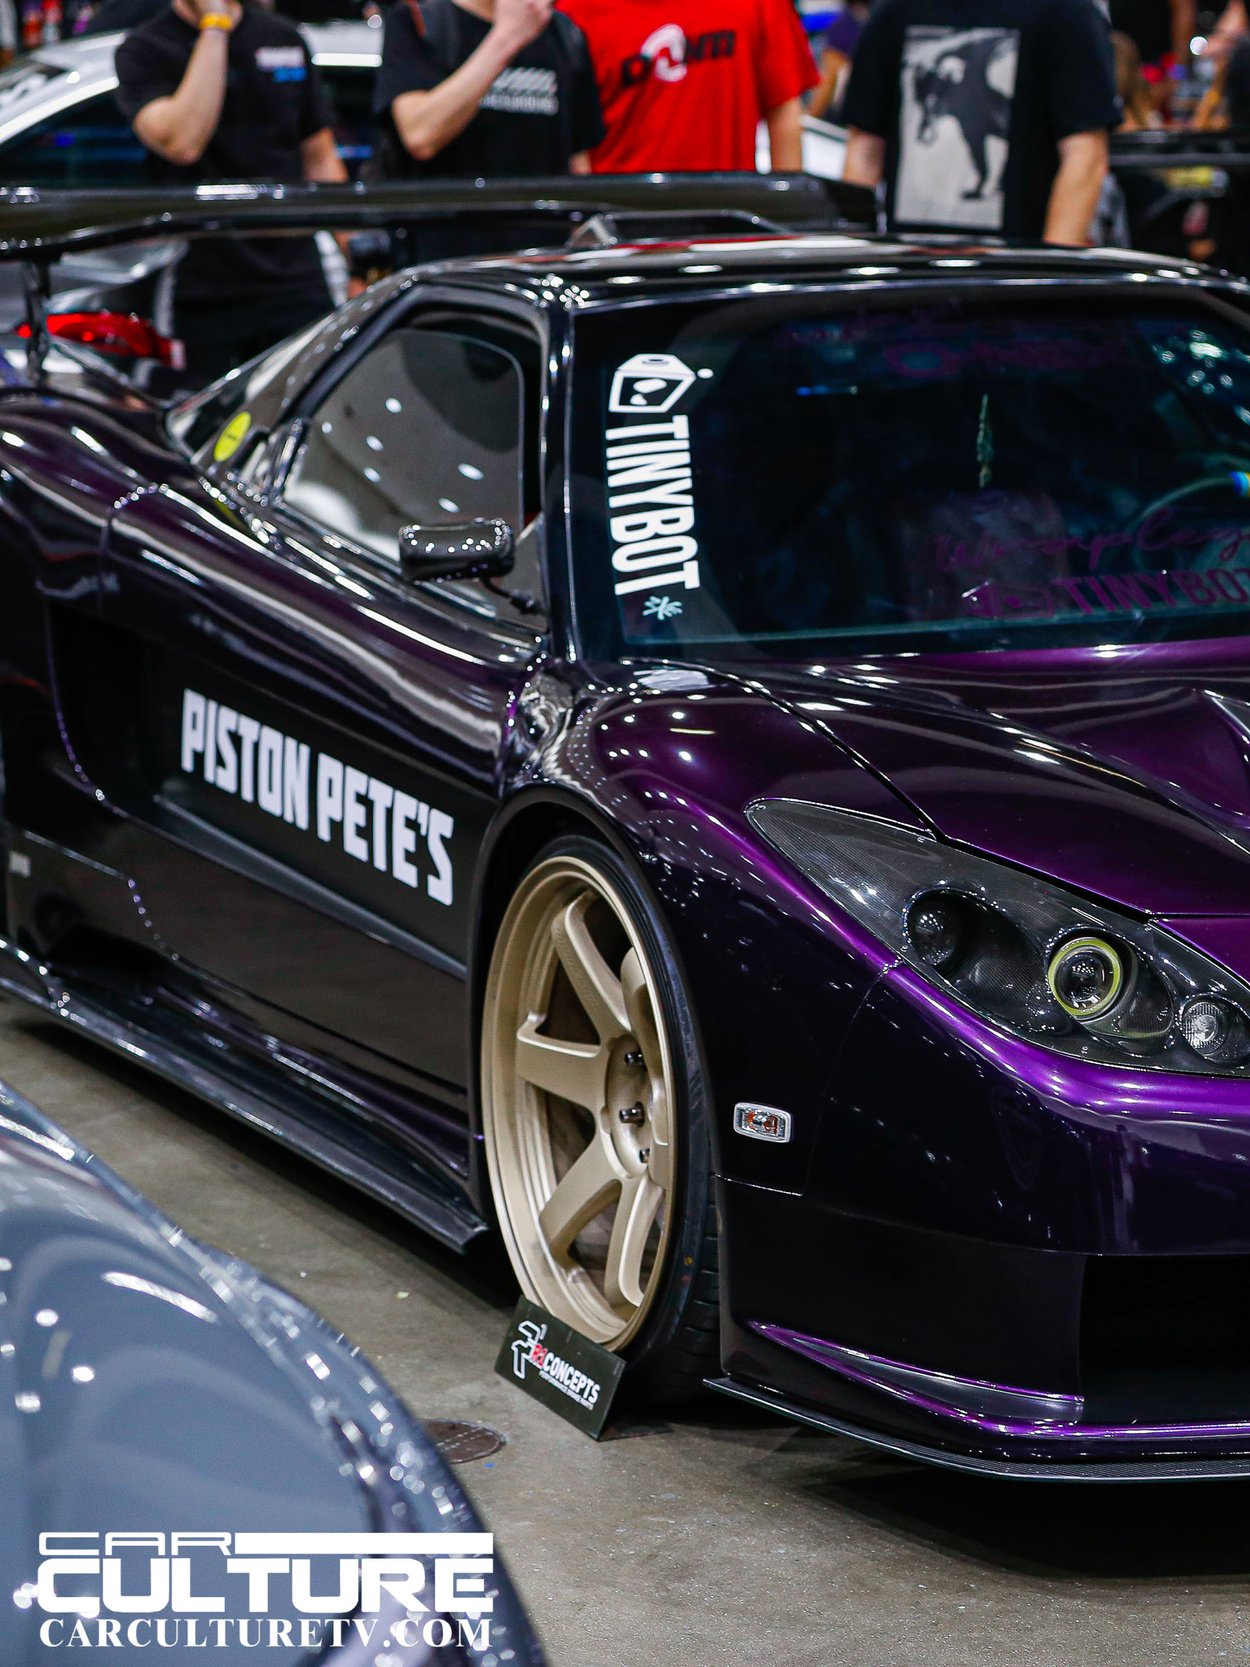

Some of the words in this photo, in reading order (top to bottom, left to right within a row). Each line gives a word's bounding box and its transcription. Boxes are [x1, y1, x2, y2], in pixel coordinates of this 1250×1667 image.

[605, 414, 700, 596] TINYBOT
[181, 688, 311, 831] PISTON
[316, 752, 454, 906] PETE'S
[542, 1352, 601, 1404] CONCEPTS
